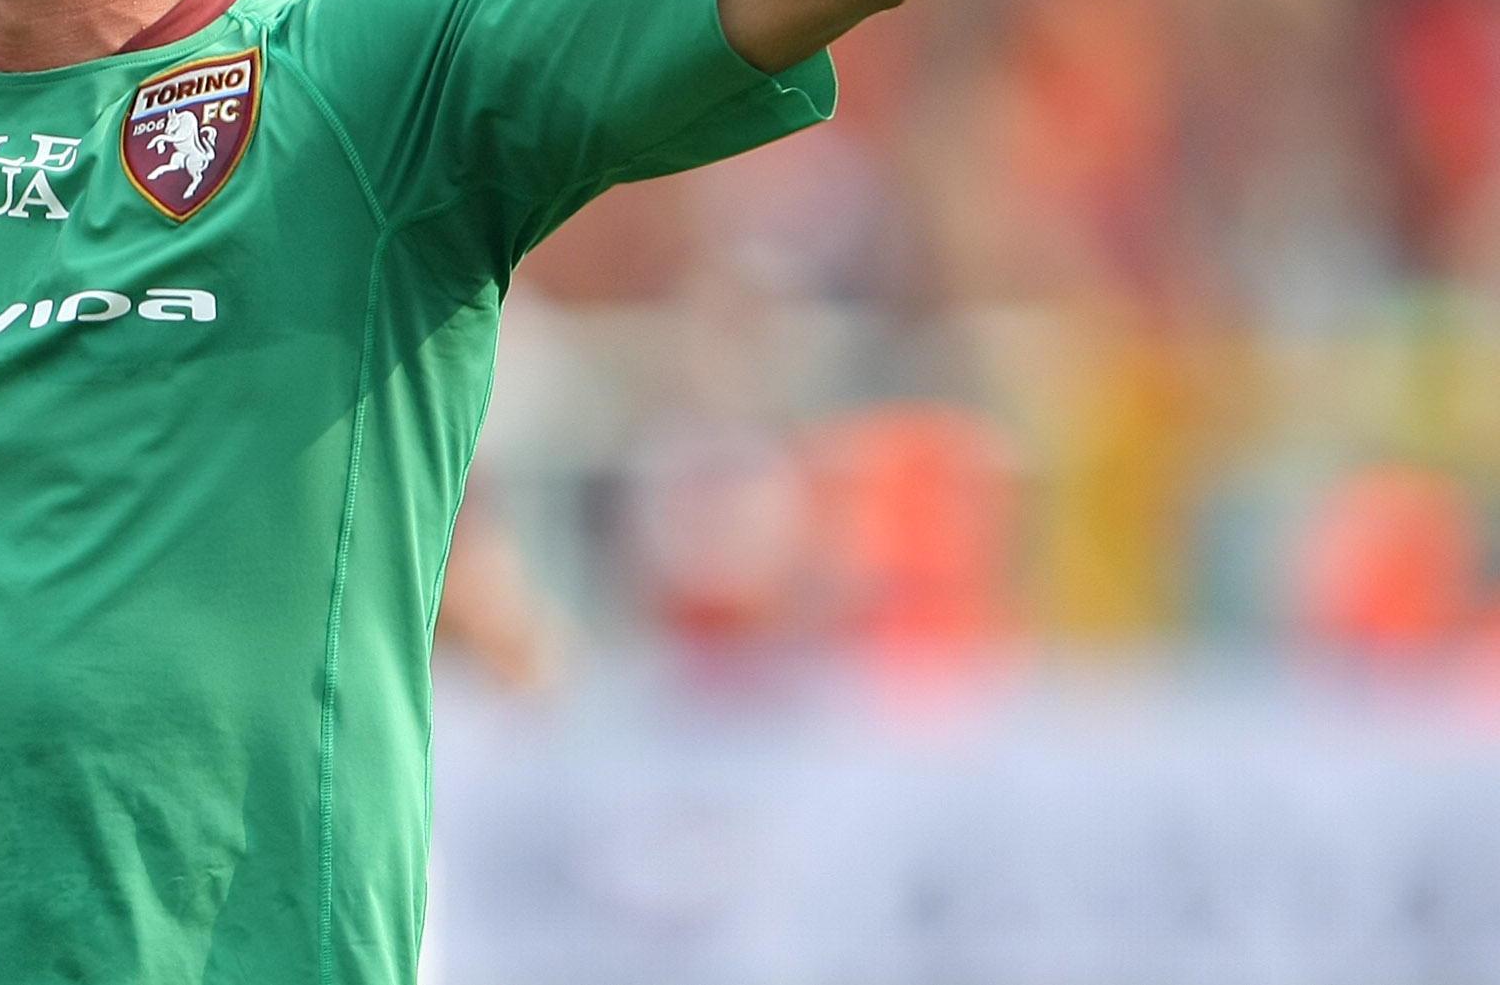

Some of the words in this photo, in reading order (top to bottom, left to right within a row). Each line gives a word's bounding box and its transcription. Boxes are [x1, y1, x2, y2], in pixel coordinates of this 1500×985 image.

[142, 68, 244, 109] TORINO
[201, 100, 240, 125] FC
[133, 119, 166, 137] 1906
